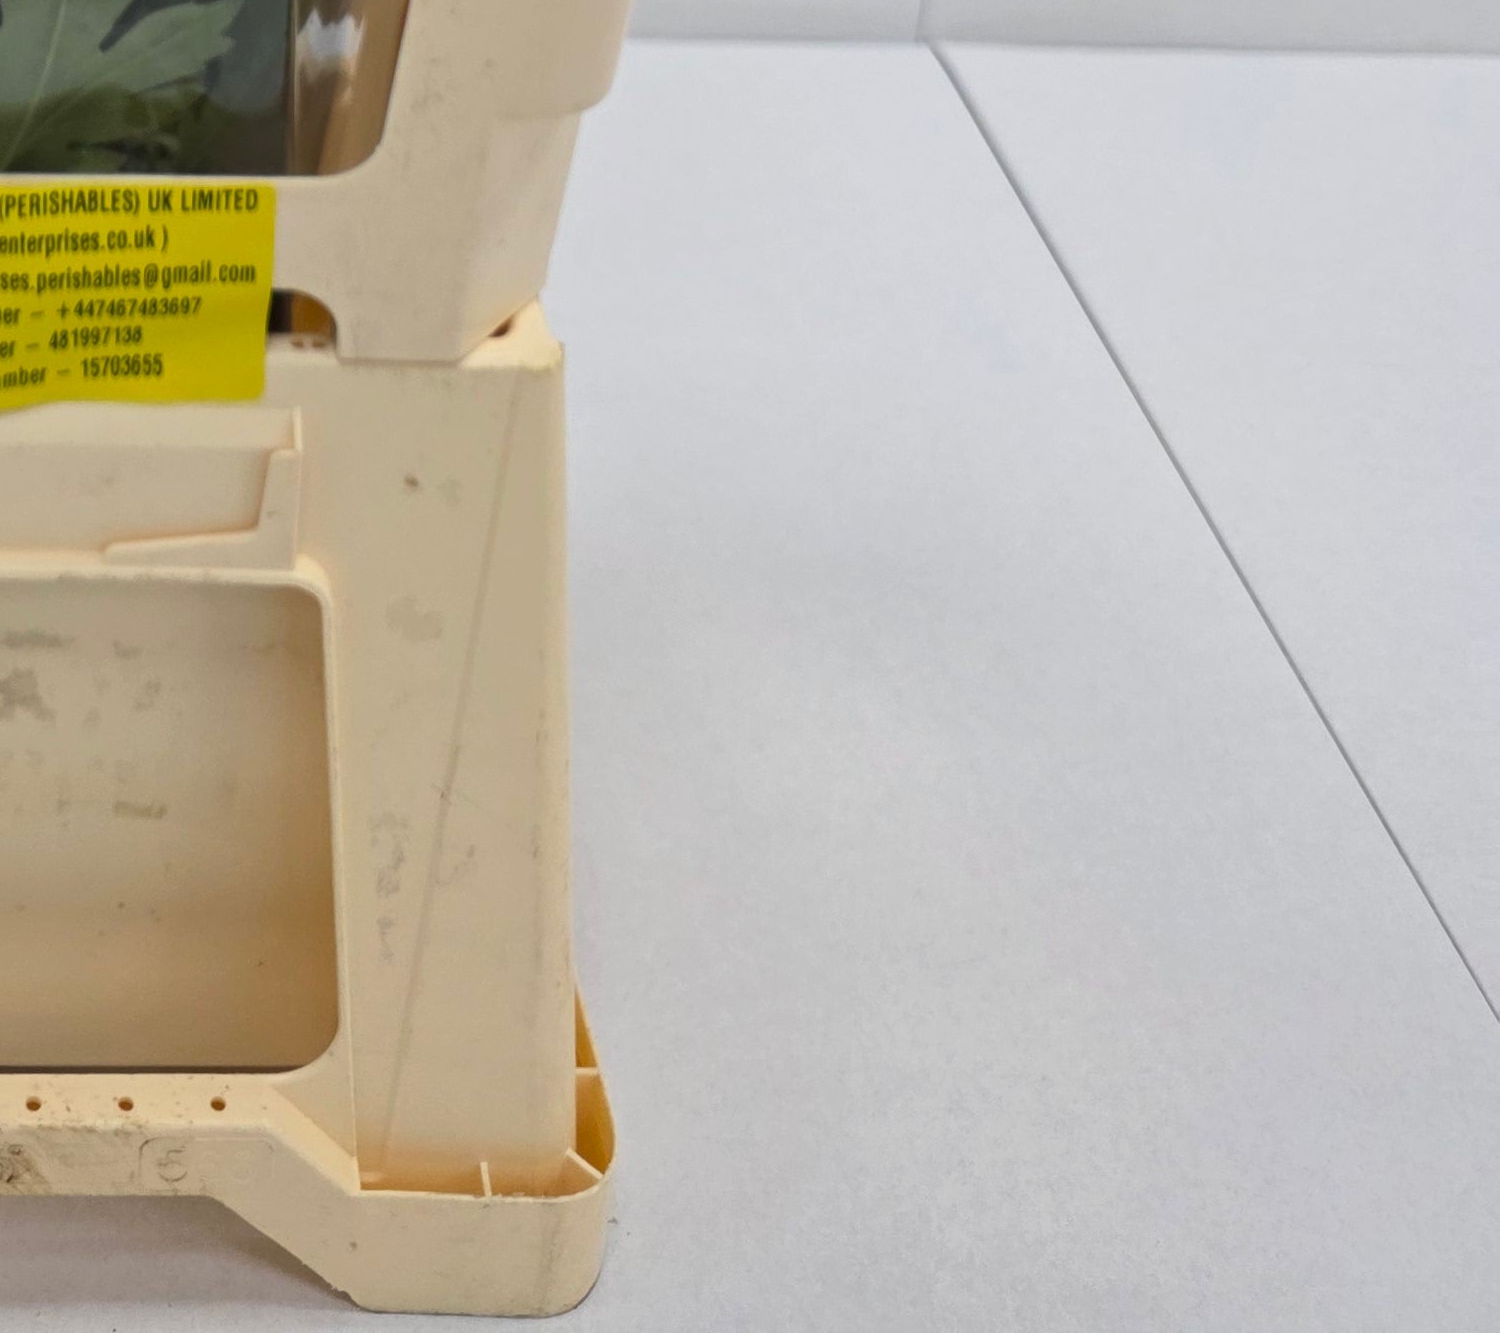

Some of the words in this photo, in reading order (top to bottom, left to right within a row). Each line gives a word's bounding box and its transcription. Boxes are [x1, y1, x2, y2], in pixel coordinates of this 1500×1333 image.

[147, 187, 173, 213] UK
[180, 187, 259, 213] LIMITED
[48, 325, 143, 352] 481997138
[81, 352, 164, 379] 15703655
